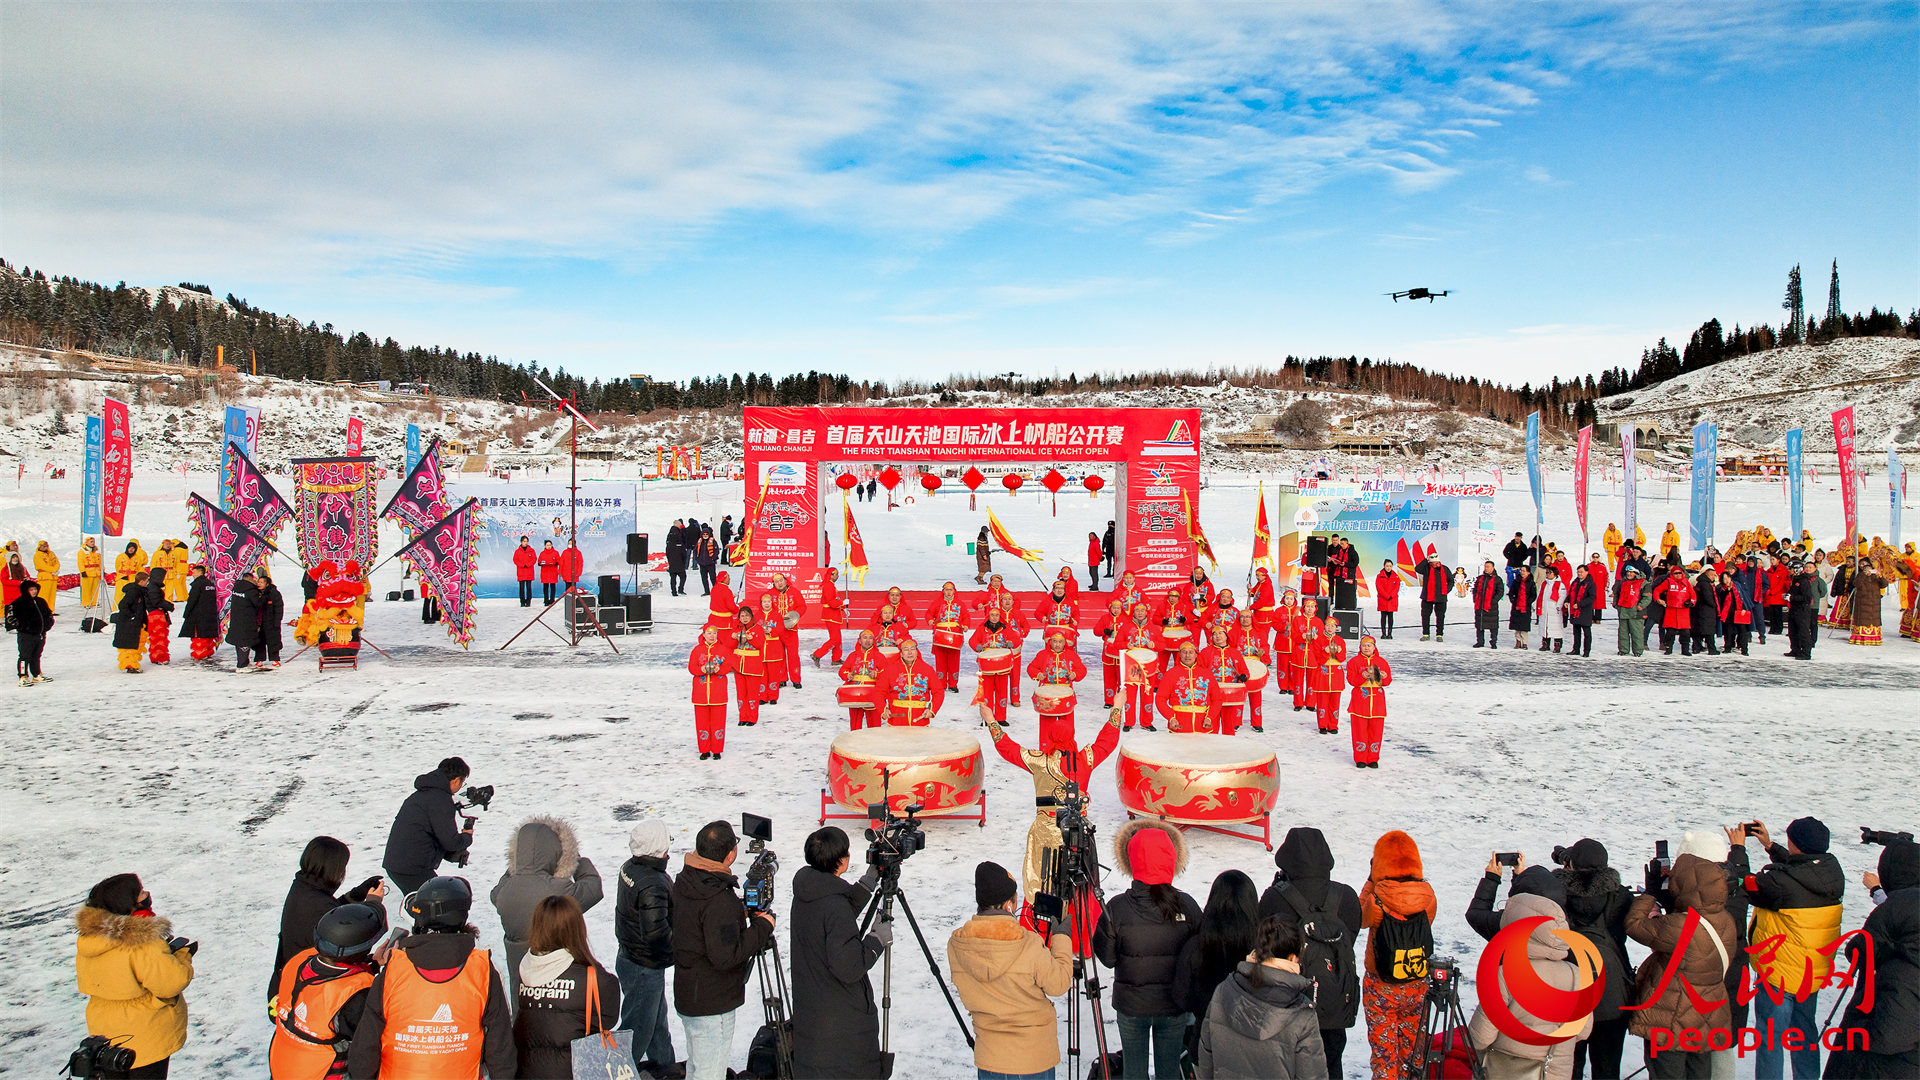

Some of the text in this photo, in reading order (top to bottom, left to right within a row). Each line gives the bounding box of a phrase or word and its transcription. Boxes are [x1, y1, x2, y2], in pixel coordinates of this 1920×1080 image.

[748, 428, 816, 444] 新疆·昌吉
[827, 419, 1125, 446] 首届天山天池国际冰上帆船公开赛
[842, 447, 859, 455] THE
[861, 447, 885, 455] FIRST
[887, 447, 930, 455] TIANSHAN
[932, 447, 966, 455] TIANCHI
[968, 447, 1036, 455] INTERNATIONAL
[1297, 478, 1318, 490] 首届
[1361, 479, 1404, 492] 冰上帆船
[1301, 487, 1355, 497] 天山天池国际
[1362, 492, 1390, 502] 公开赛
[519, 983, 570, 1000] Program
[408, 1025, 459, 1034] 首届天山天池
[395, 1033, 469, 1043] 国际冰上帆船公开赛
[394, 1046, 429, 1055] INTERNATIONAL
